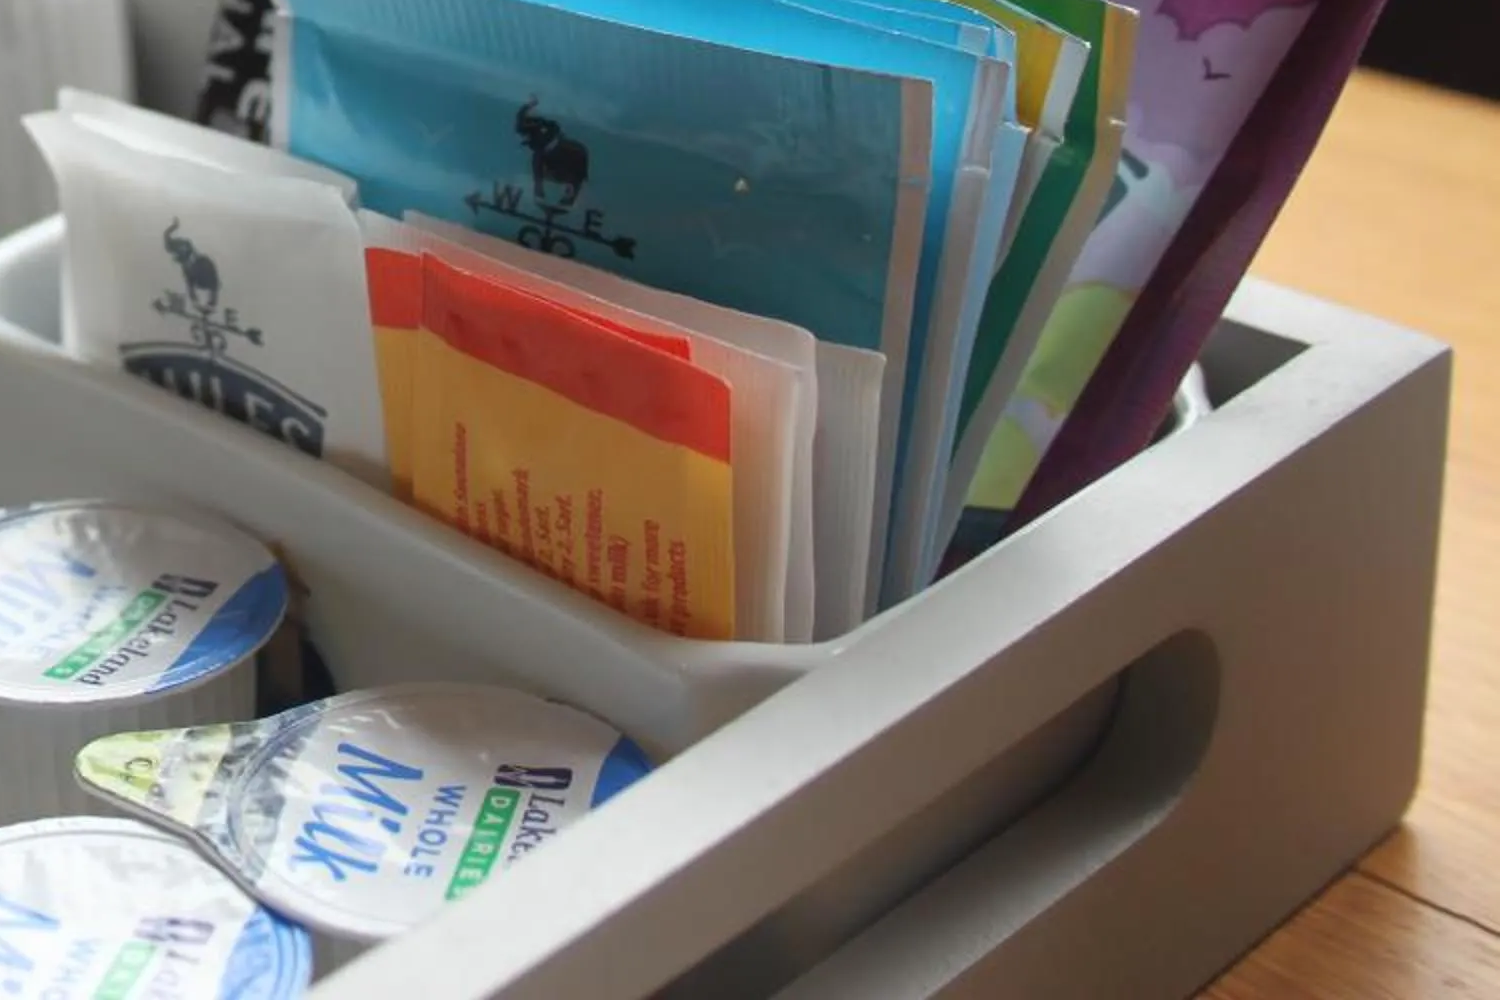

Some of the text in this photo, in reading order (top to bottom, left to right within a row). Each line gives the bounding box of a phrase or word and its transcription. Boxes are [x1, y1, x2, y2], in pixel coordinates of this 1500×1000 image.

[76, 597, 198, 688] Lakeland
[295, 742, 424, 881] Milk
[403, 784, 467, 877] WHOLE
